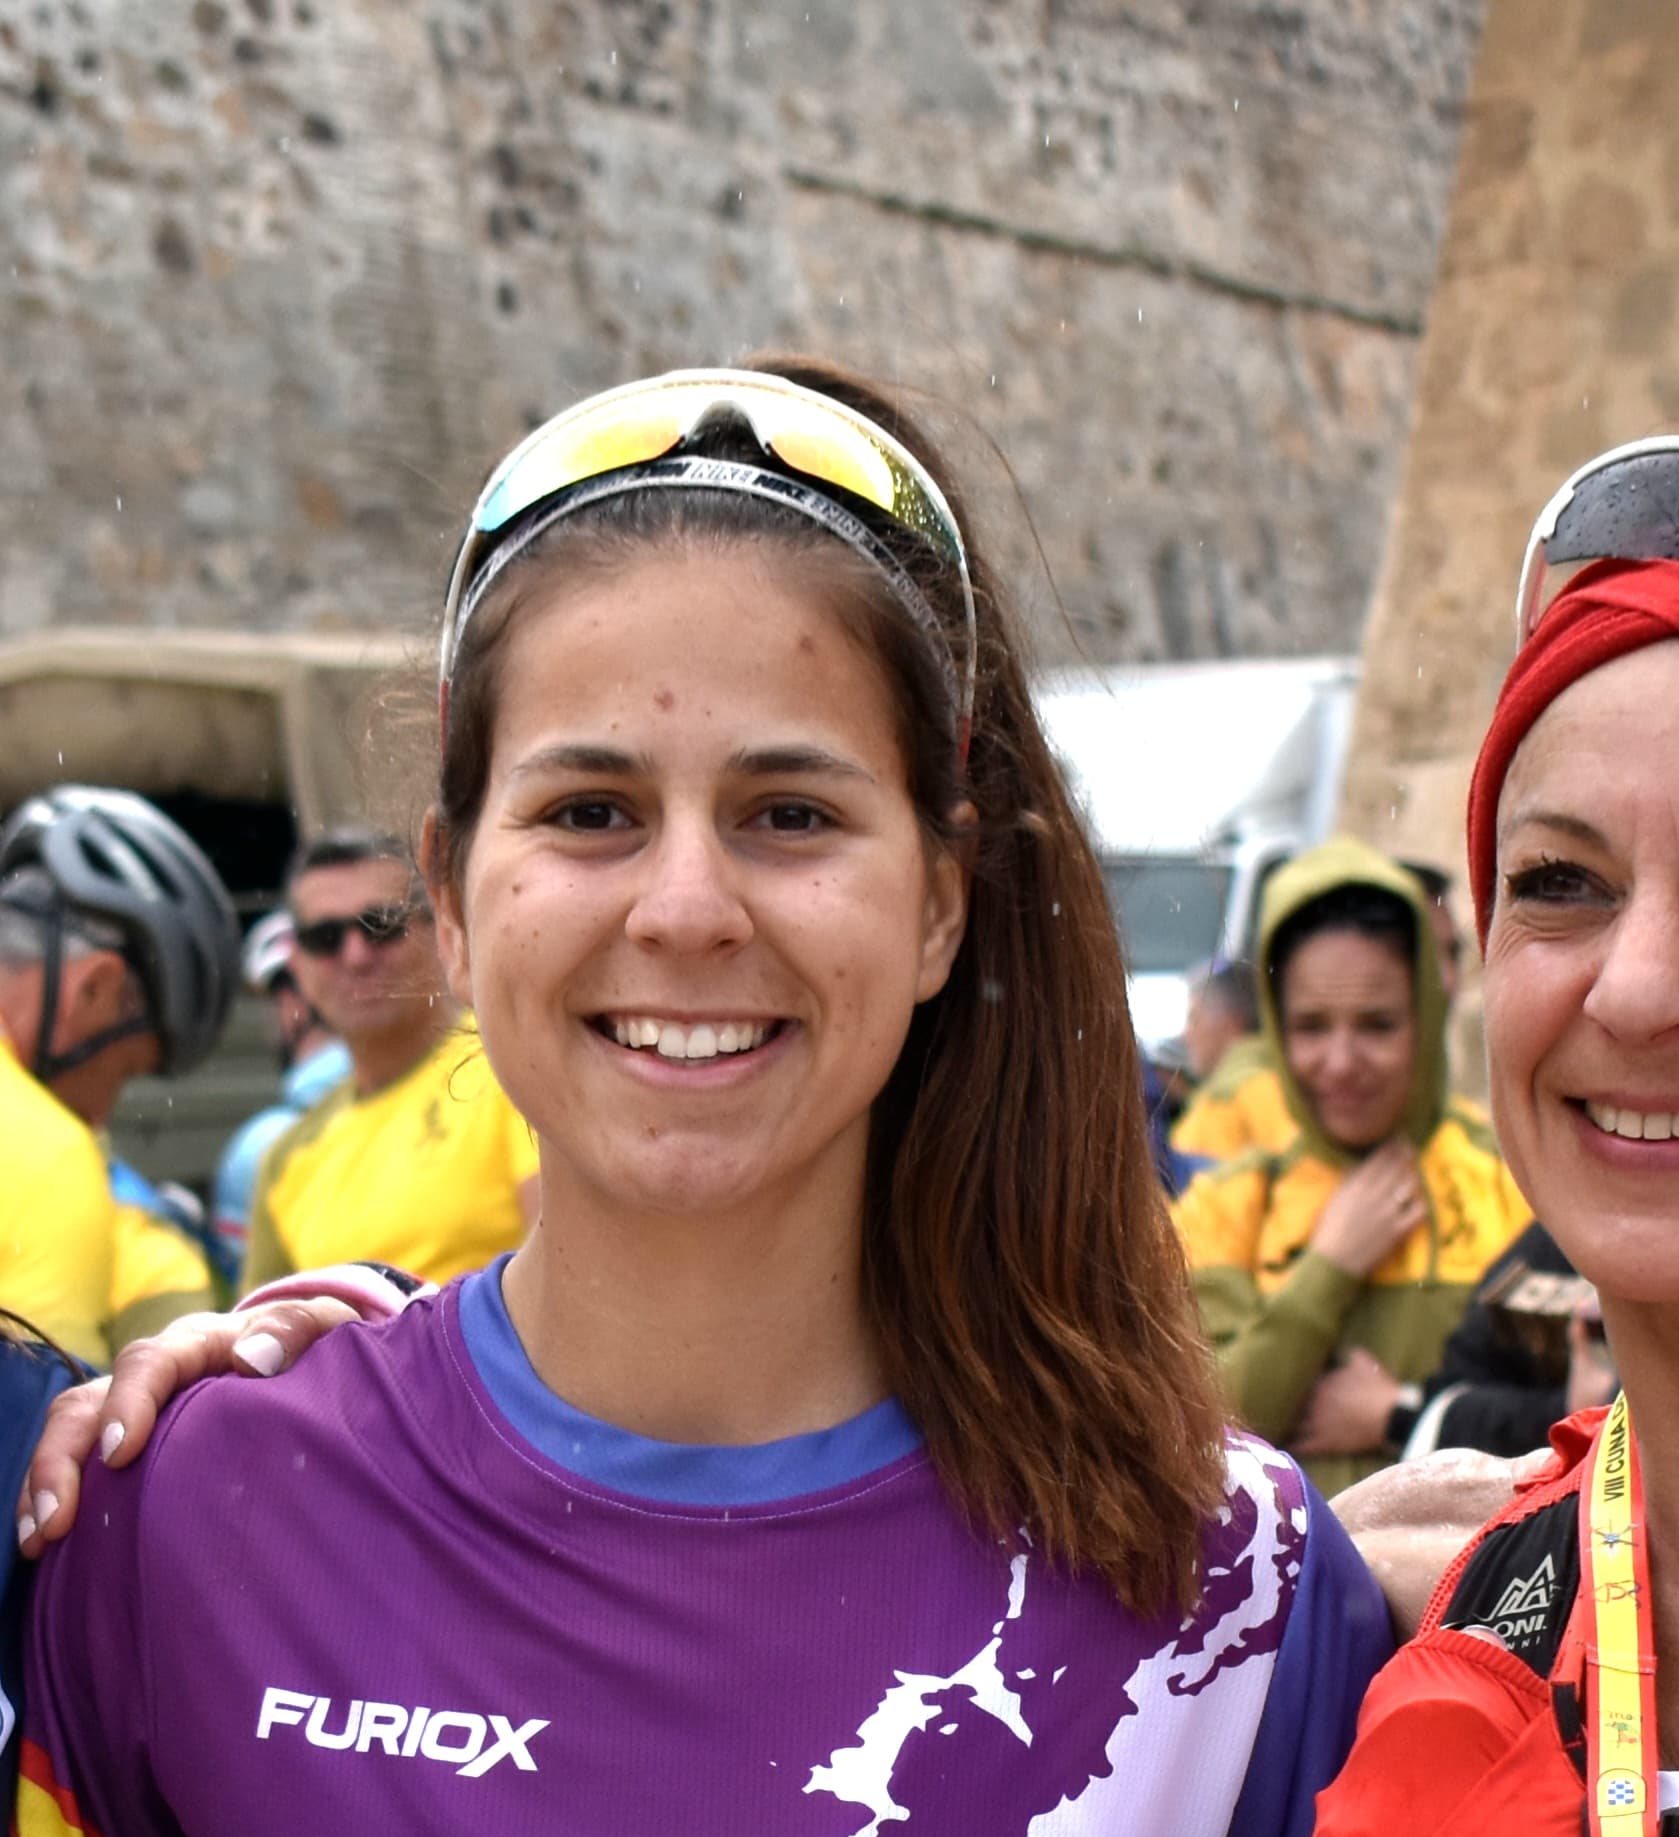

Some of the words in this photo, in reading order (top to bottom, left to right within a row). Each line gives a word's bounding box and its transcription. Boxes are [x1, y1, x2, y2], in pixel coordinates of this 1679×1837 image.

[1605, 1416, 1625, 1474] CUNA
[1603, 1475, 1625, 1503] VIII
[256, 1686, 552, 1778] FURIOX
